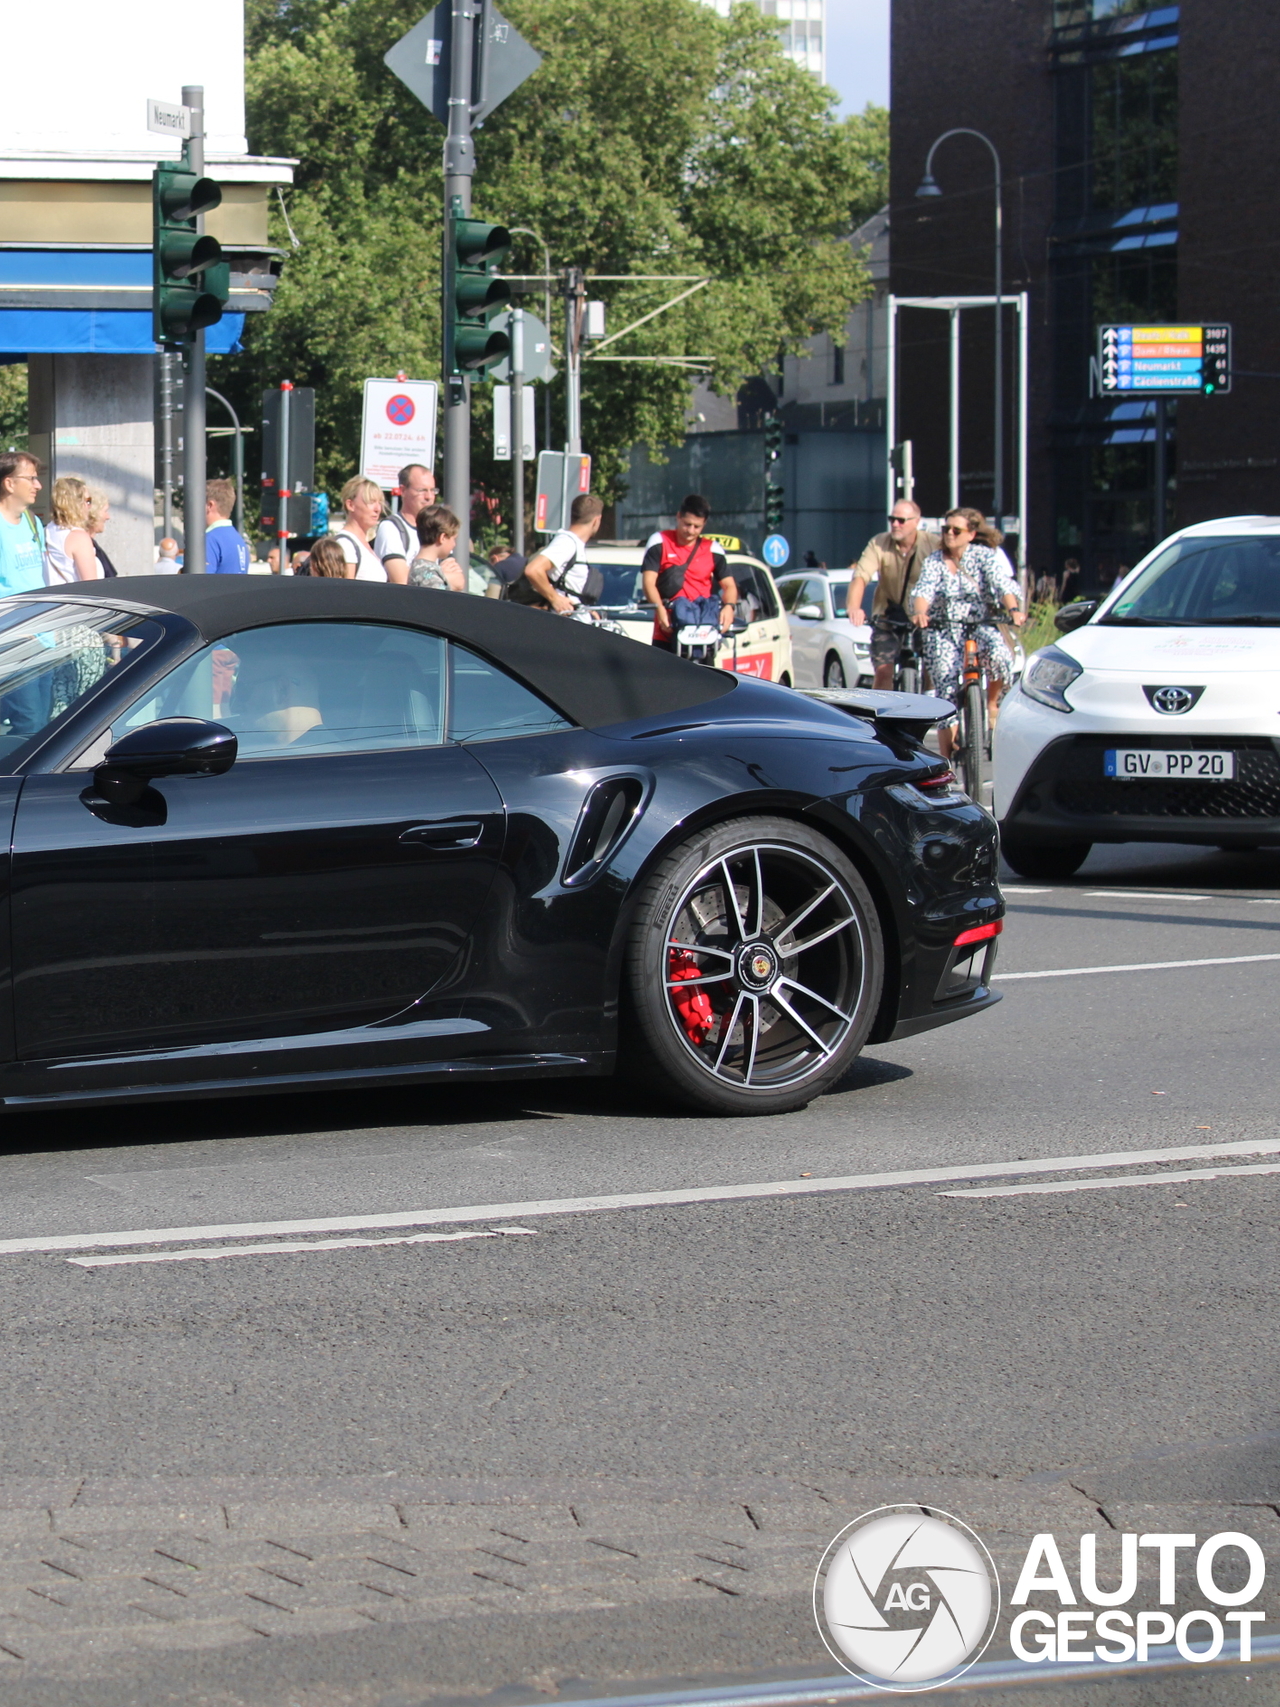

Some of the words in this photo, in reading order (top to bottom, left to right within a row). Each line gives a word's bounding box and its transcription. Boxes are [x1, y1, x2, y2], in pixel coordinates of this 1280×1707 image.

[154, 105, 185, 130] Neumarkt
[1134, 362, 1182, 371] Neumarkt
[1134, 376, 1198, 386] Cäcilienstraße
[1124, 754, 1150, 774] GV
[1166, 755, 1193, 774] PP
[1198, 755, 1224, 775] 20
[652, 884, 680, 930] PIRELLI
